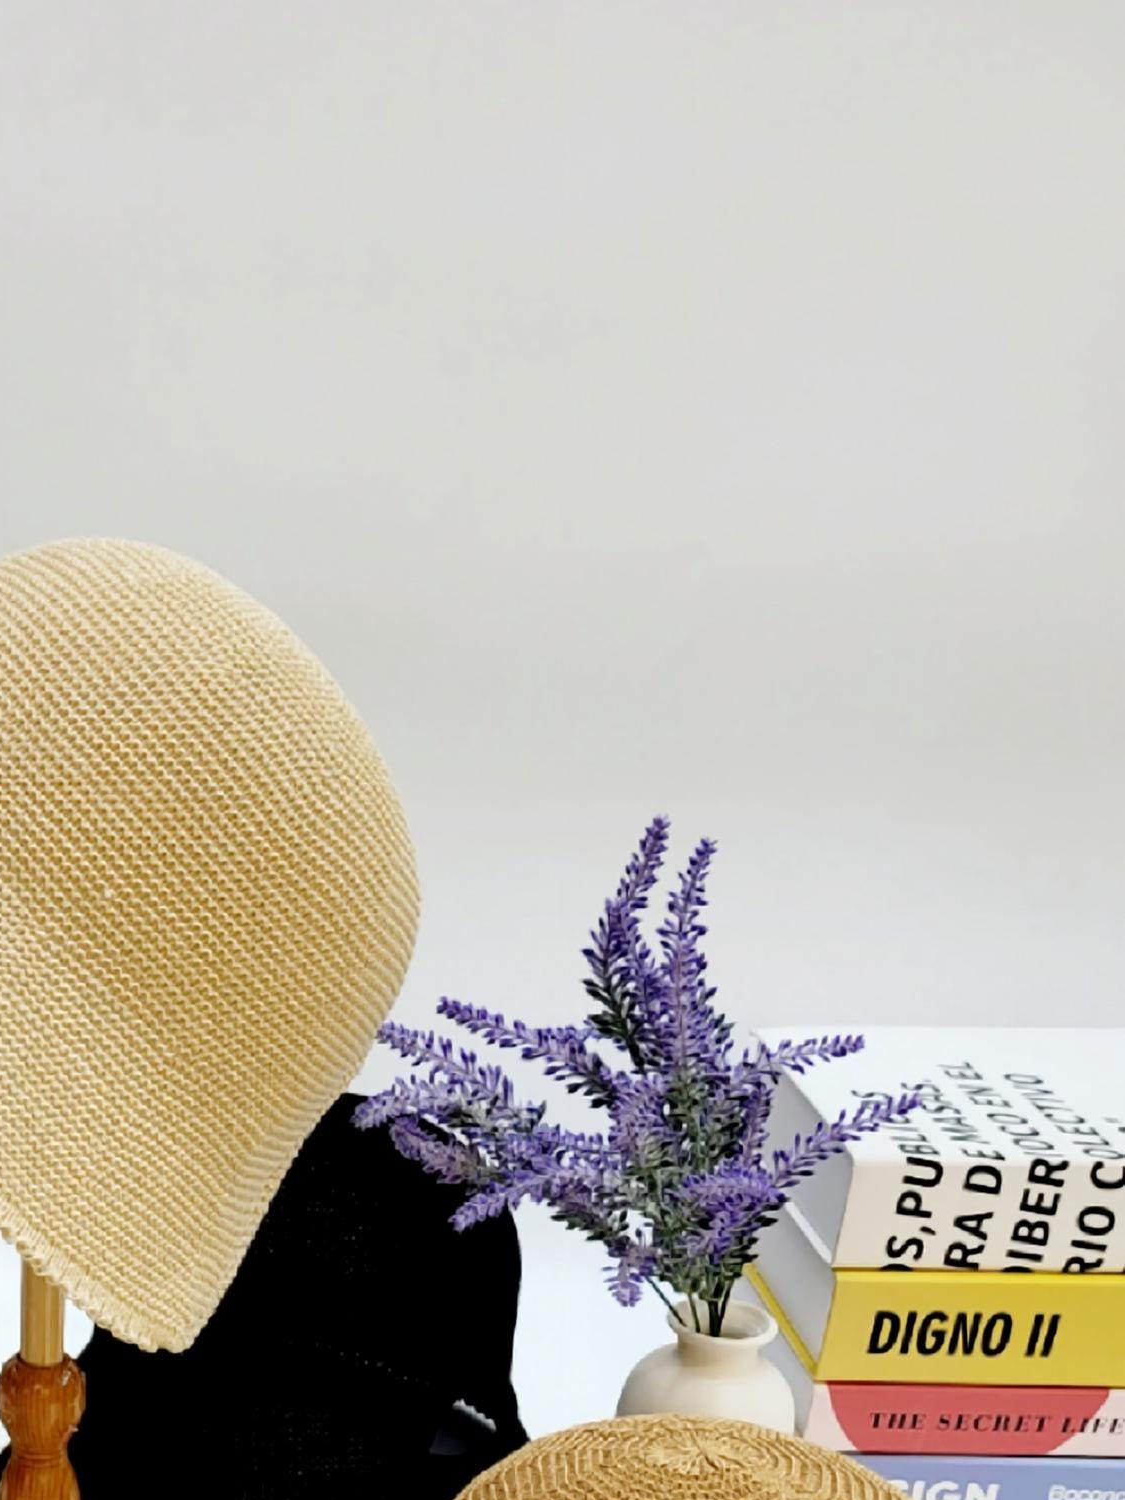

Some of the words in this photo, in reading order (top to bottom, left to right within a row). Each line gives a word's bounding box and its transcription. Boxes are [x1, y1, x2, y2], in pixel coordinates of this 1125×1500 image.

[867, 1311, 1013, 1357] DIGNO
[1024, 1314, 1062, 1358] II
[870, 1412, 927, 1430] THE
[936, 1413, 1053, 1433] SECRET
[1061, 1417, 1125, 1434] LIFE
